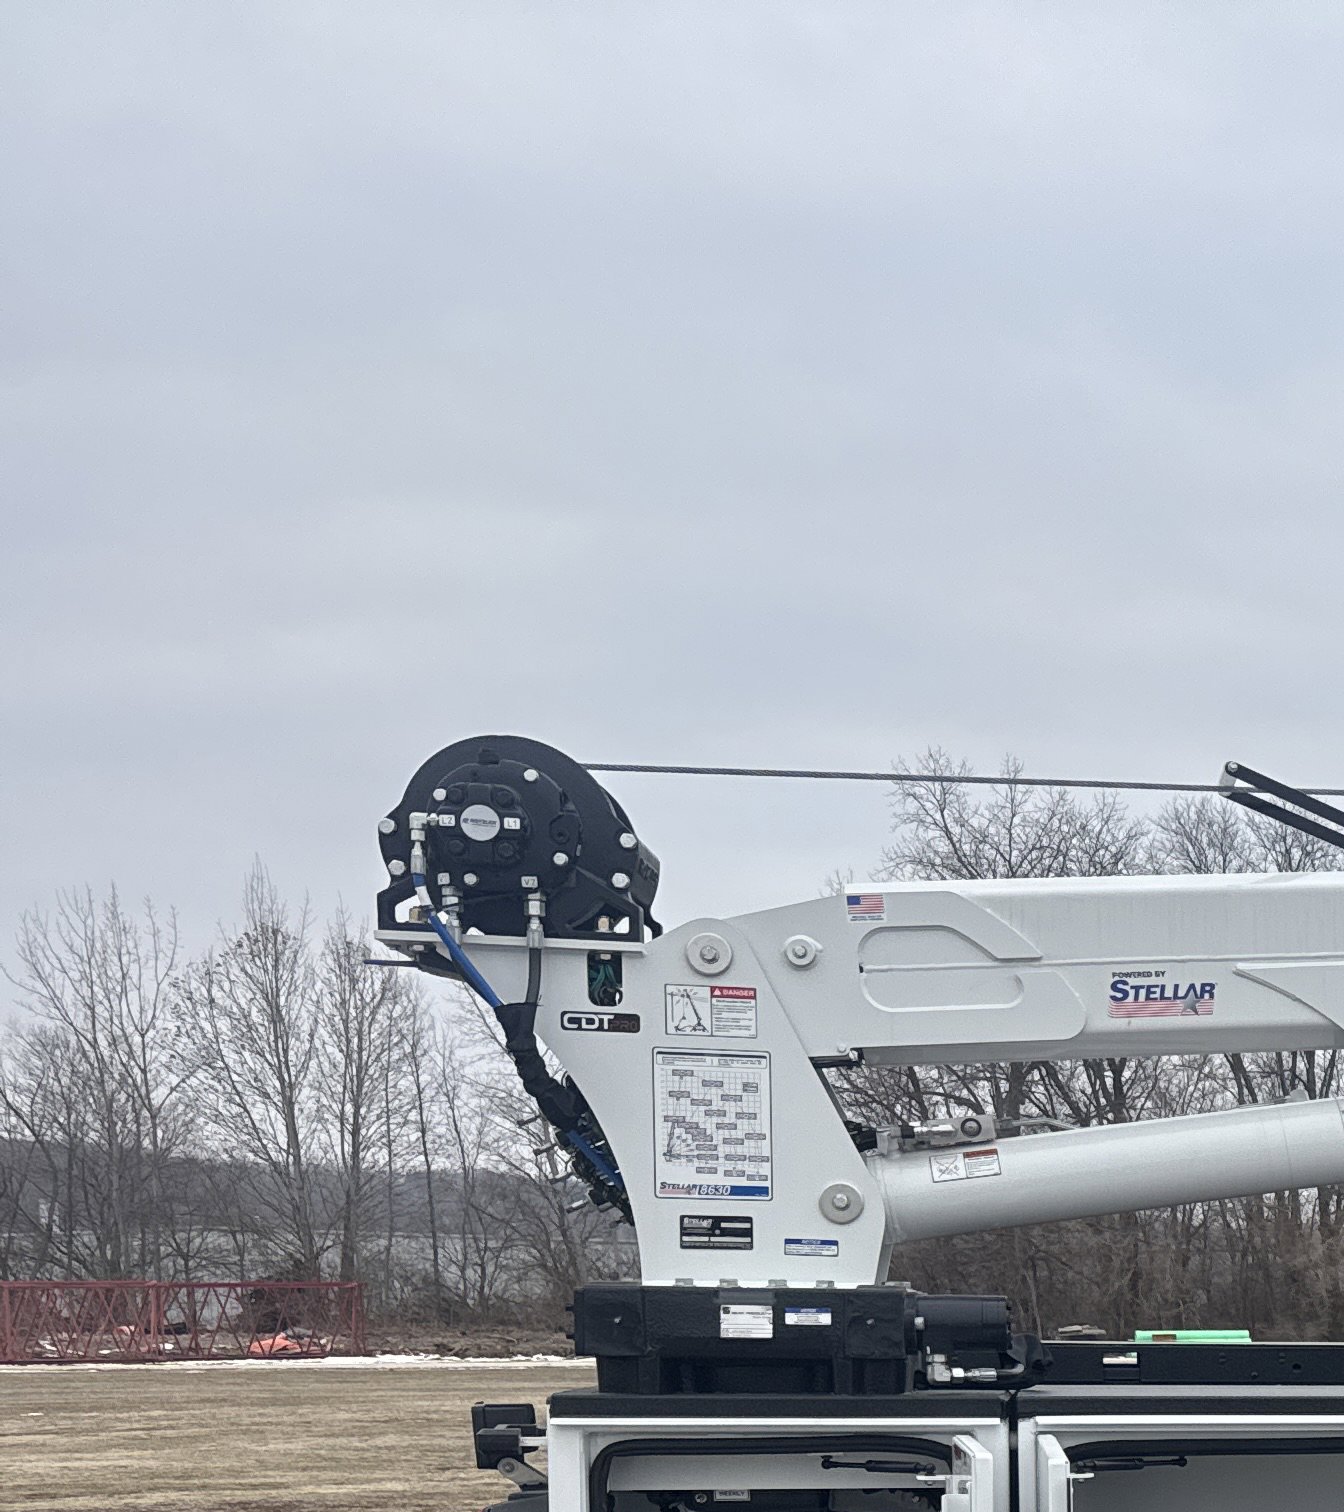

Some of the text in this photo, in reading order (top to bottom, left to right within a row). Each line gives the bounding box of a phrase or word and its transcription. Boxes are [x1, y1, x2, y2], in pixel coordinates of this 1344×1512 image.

[1111, 970, 1167, 979] POWERED BY
[1109, 979, 1217, 1003] STELLAR
[699, 1184, 732, 1196] 8630
